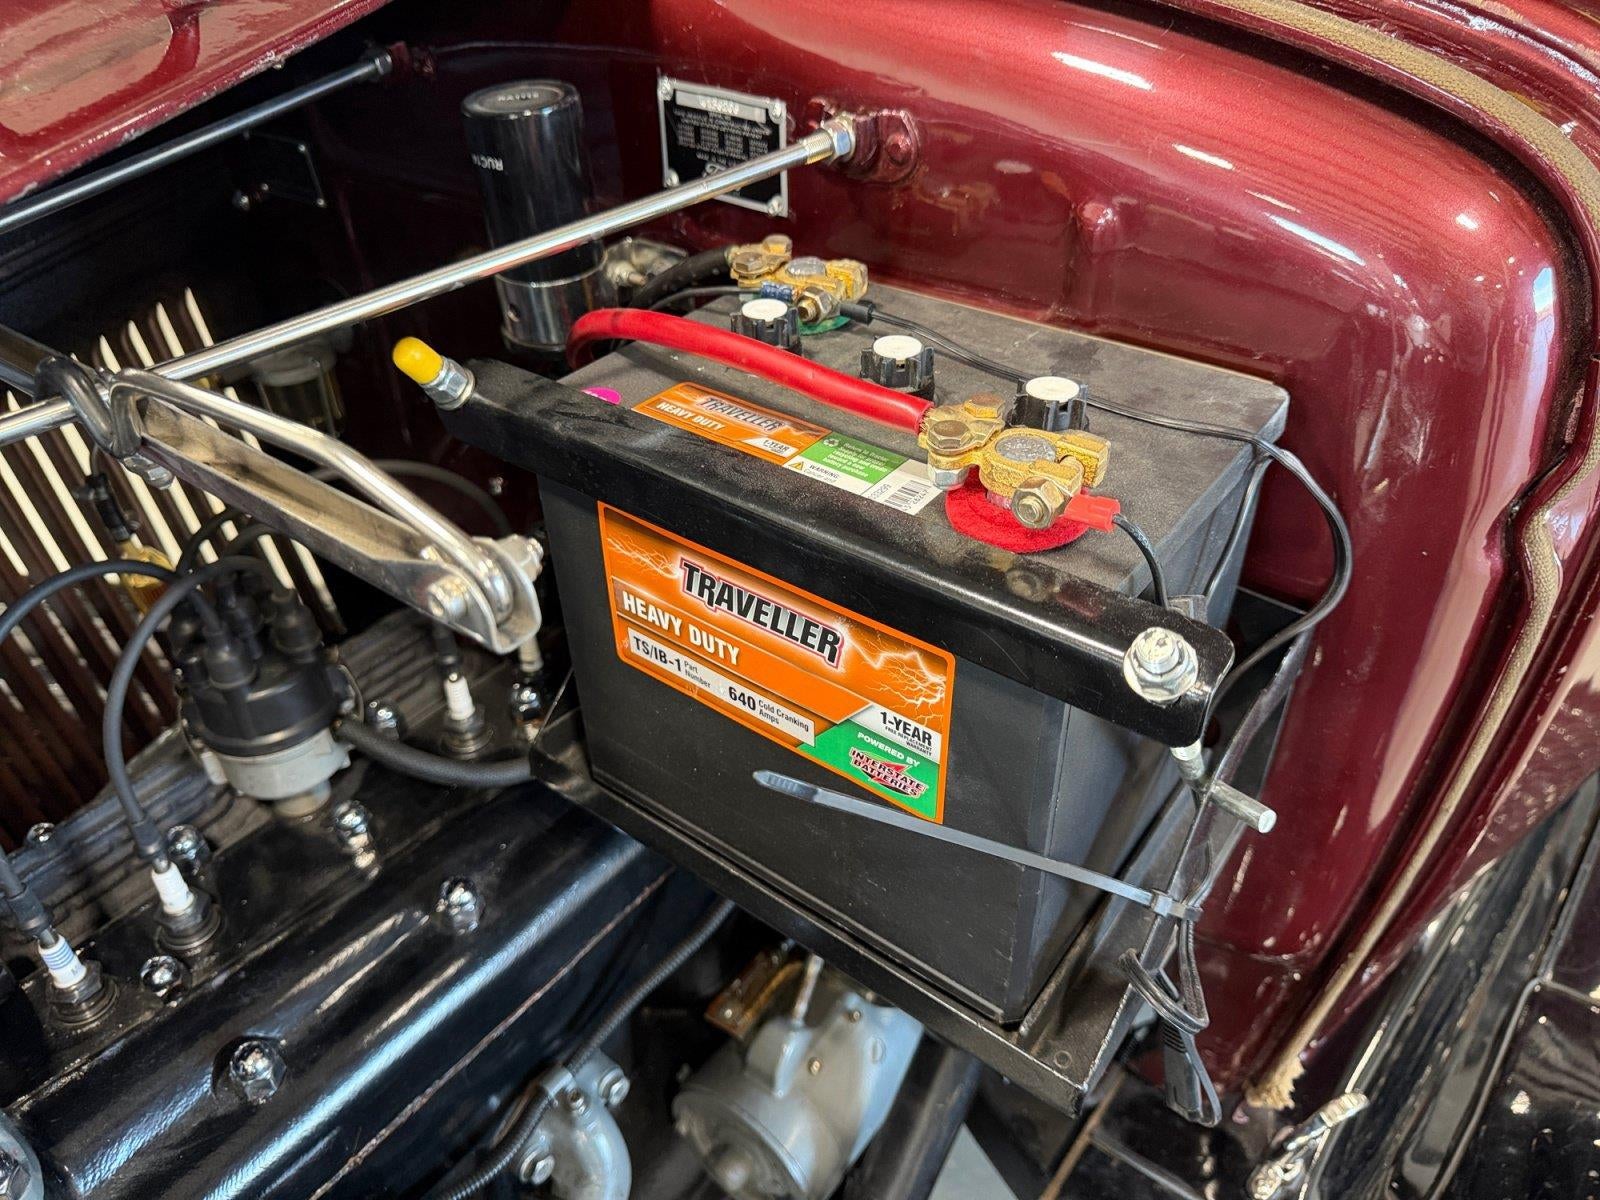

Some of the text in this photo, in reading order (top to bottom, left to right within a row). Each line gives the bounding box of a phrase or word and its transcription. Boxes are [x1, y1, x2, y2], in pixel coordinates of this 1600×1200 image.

[656, 402, 725, 431] HEAVY DUTY
[700, 397, 785, 432] TRAVELLER
[622, 591, 740, 666] HEAVY DUTY
[681, 557, 844, 667] TRAVELLER
[633, 635, 682, 673] TS/IB-1
[684, 660, 699, 674] Part
[685, 669, 711, 689] Number
[728, 685, 757, 711] 640
[758, 699, 810, 733] Cold Cranking
[758, 710, 780, 726] Amps
[880, 711, 932, 747] 1-YEAR
[885, 726, 897, 736] FREE
[857, 731, 921, 768] POWERED BY
[906, 740, 932, 757] WARRANTY
[851, 749, 926, 792] INTERSTATE
[853, 758, 919, 797] BATTERIES
